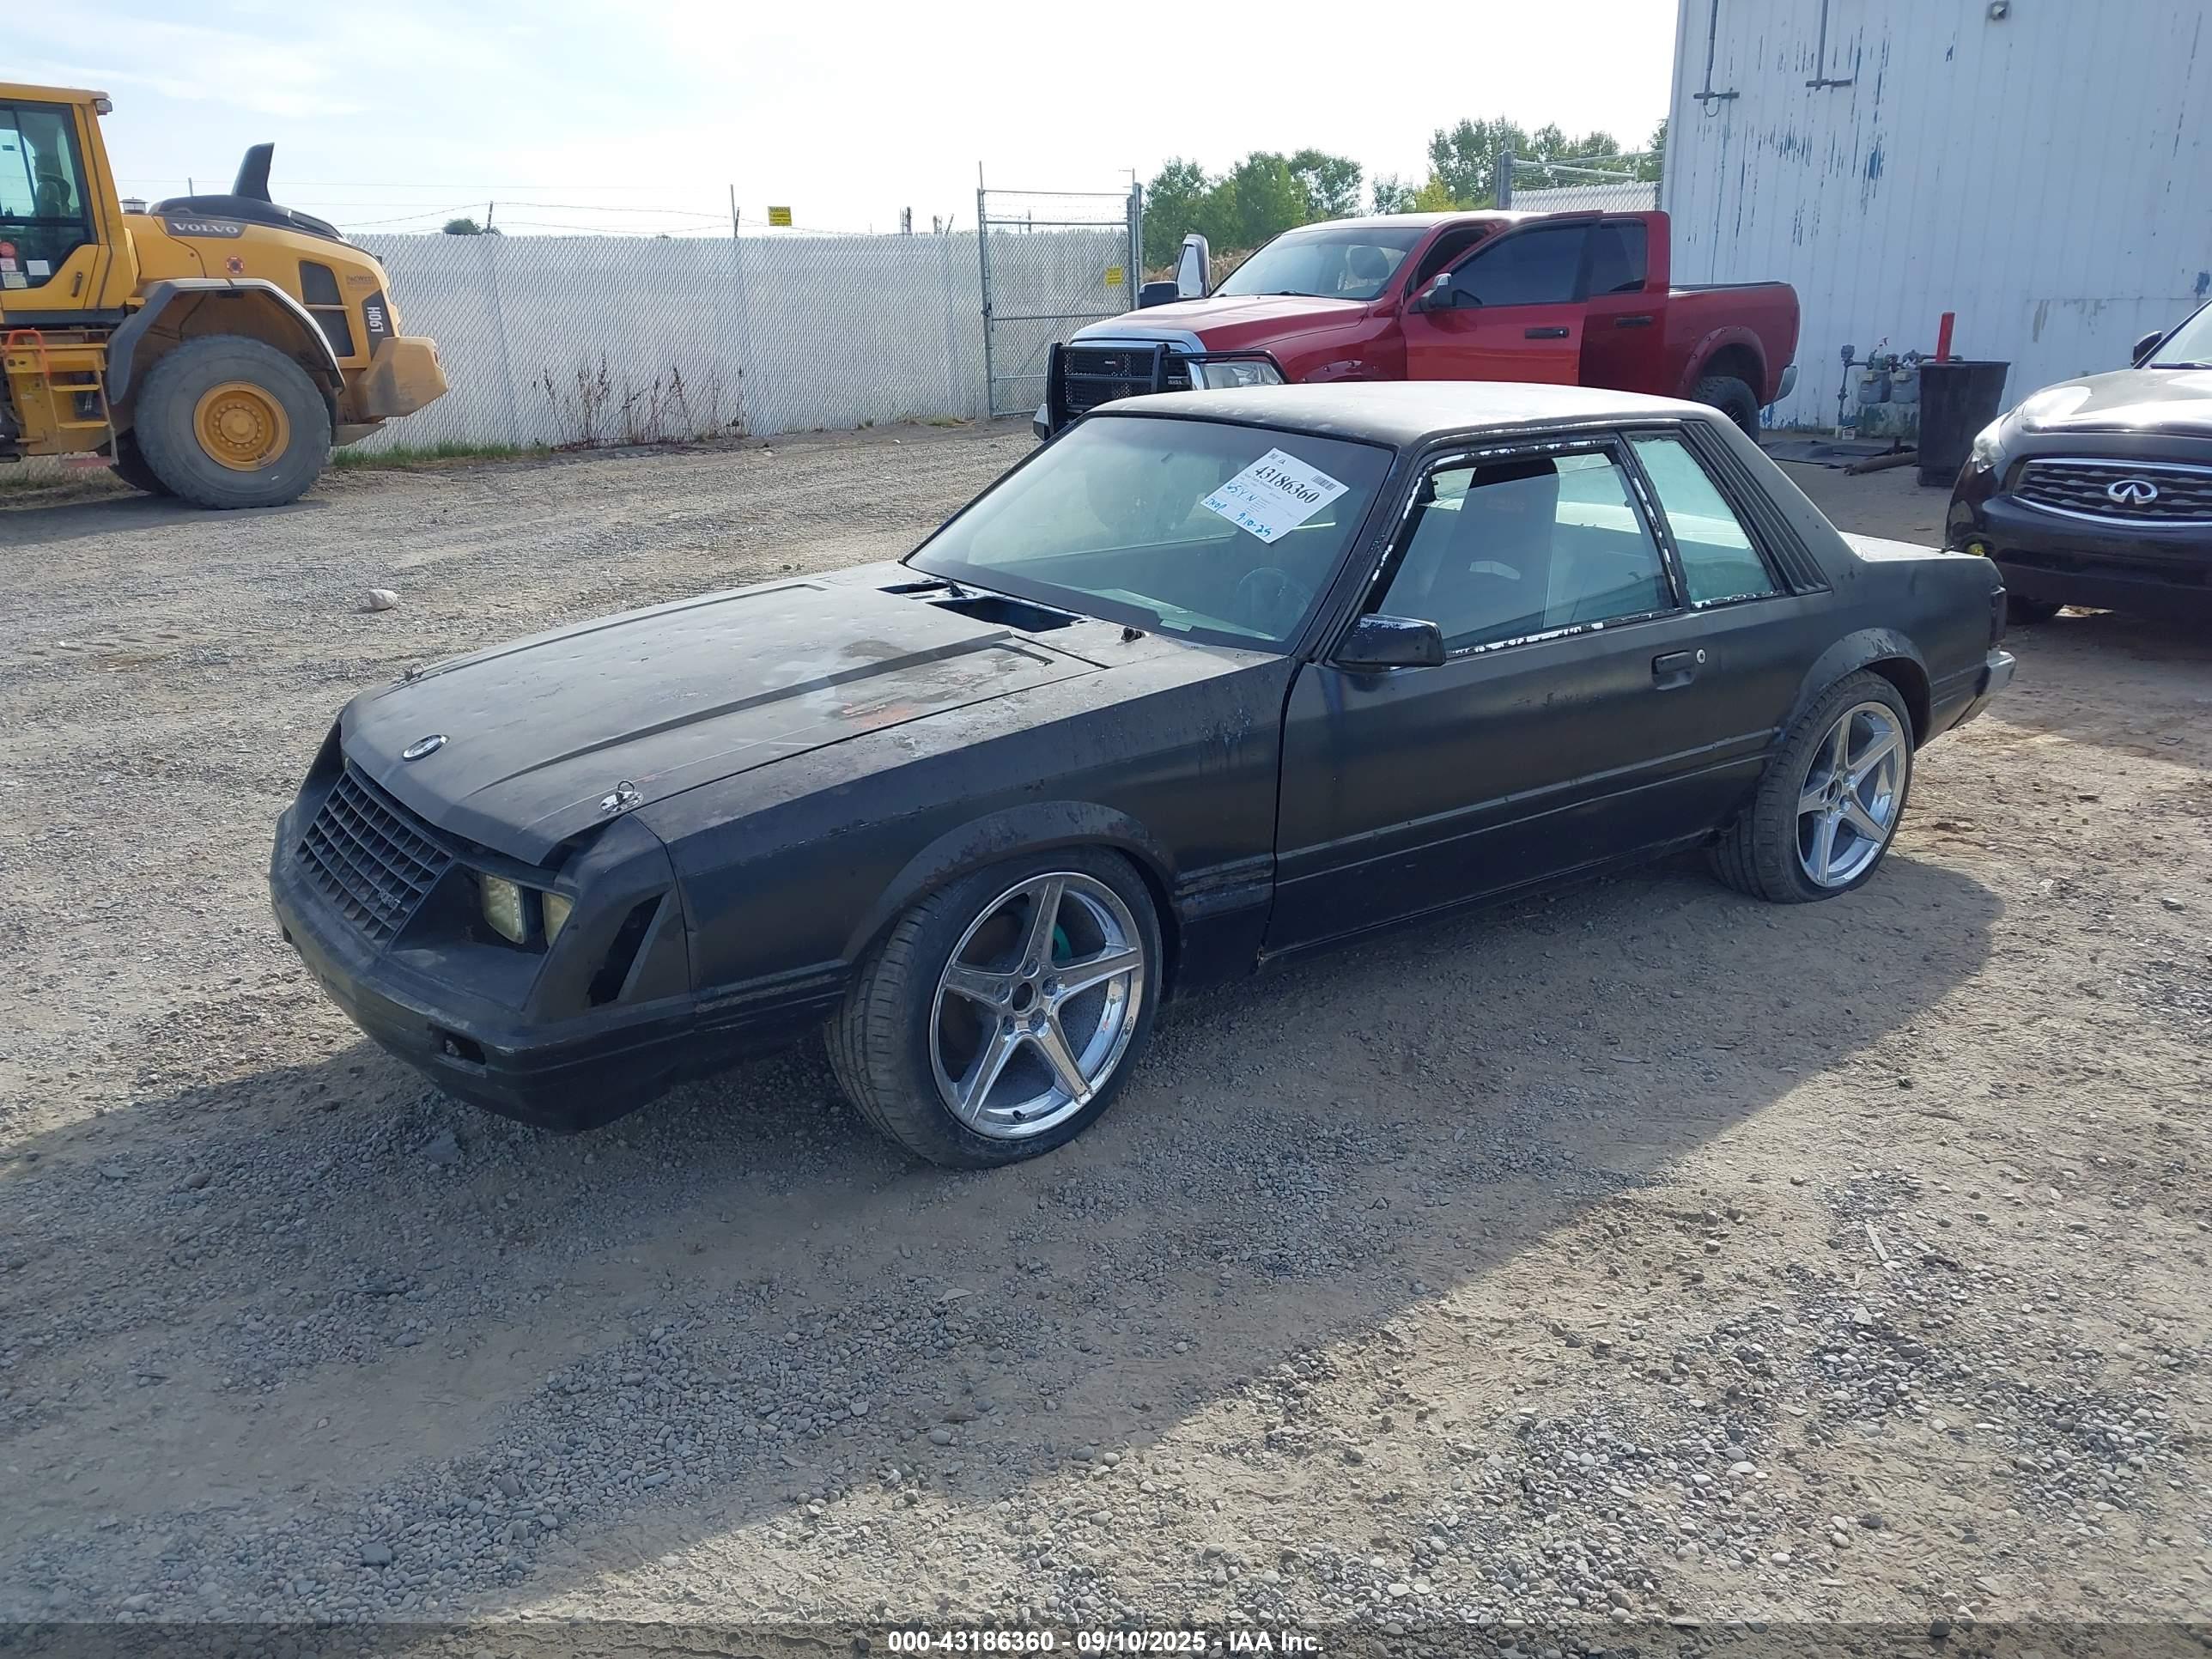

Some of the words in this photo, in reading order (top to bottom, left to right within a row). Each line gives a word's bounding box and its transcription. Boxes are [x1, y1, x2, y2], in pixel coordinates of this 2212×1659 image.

[172, 222, 238, 234] VOLVO
[367, 307, 384, 332] L90H
[1255, 465, 1321, 504] 43186360
